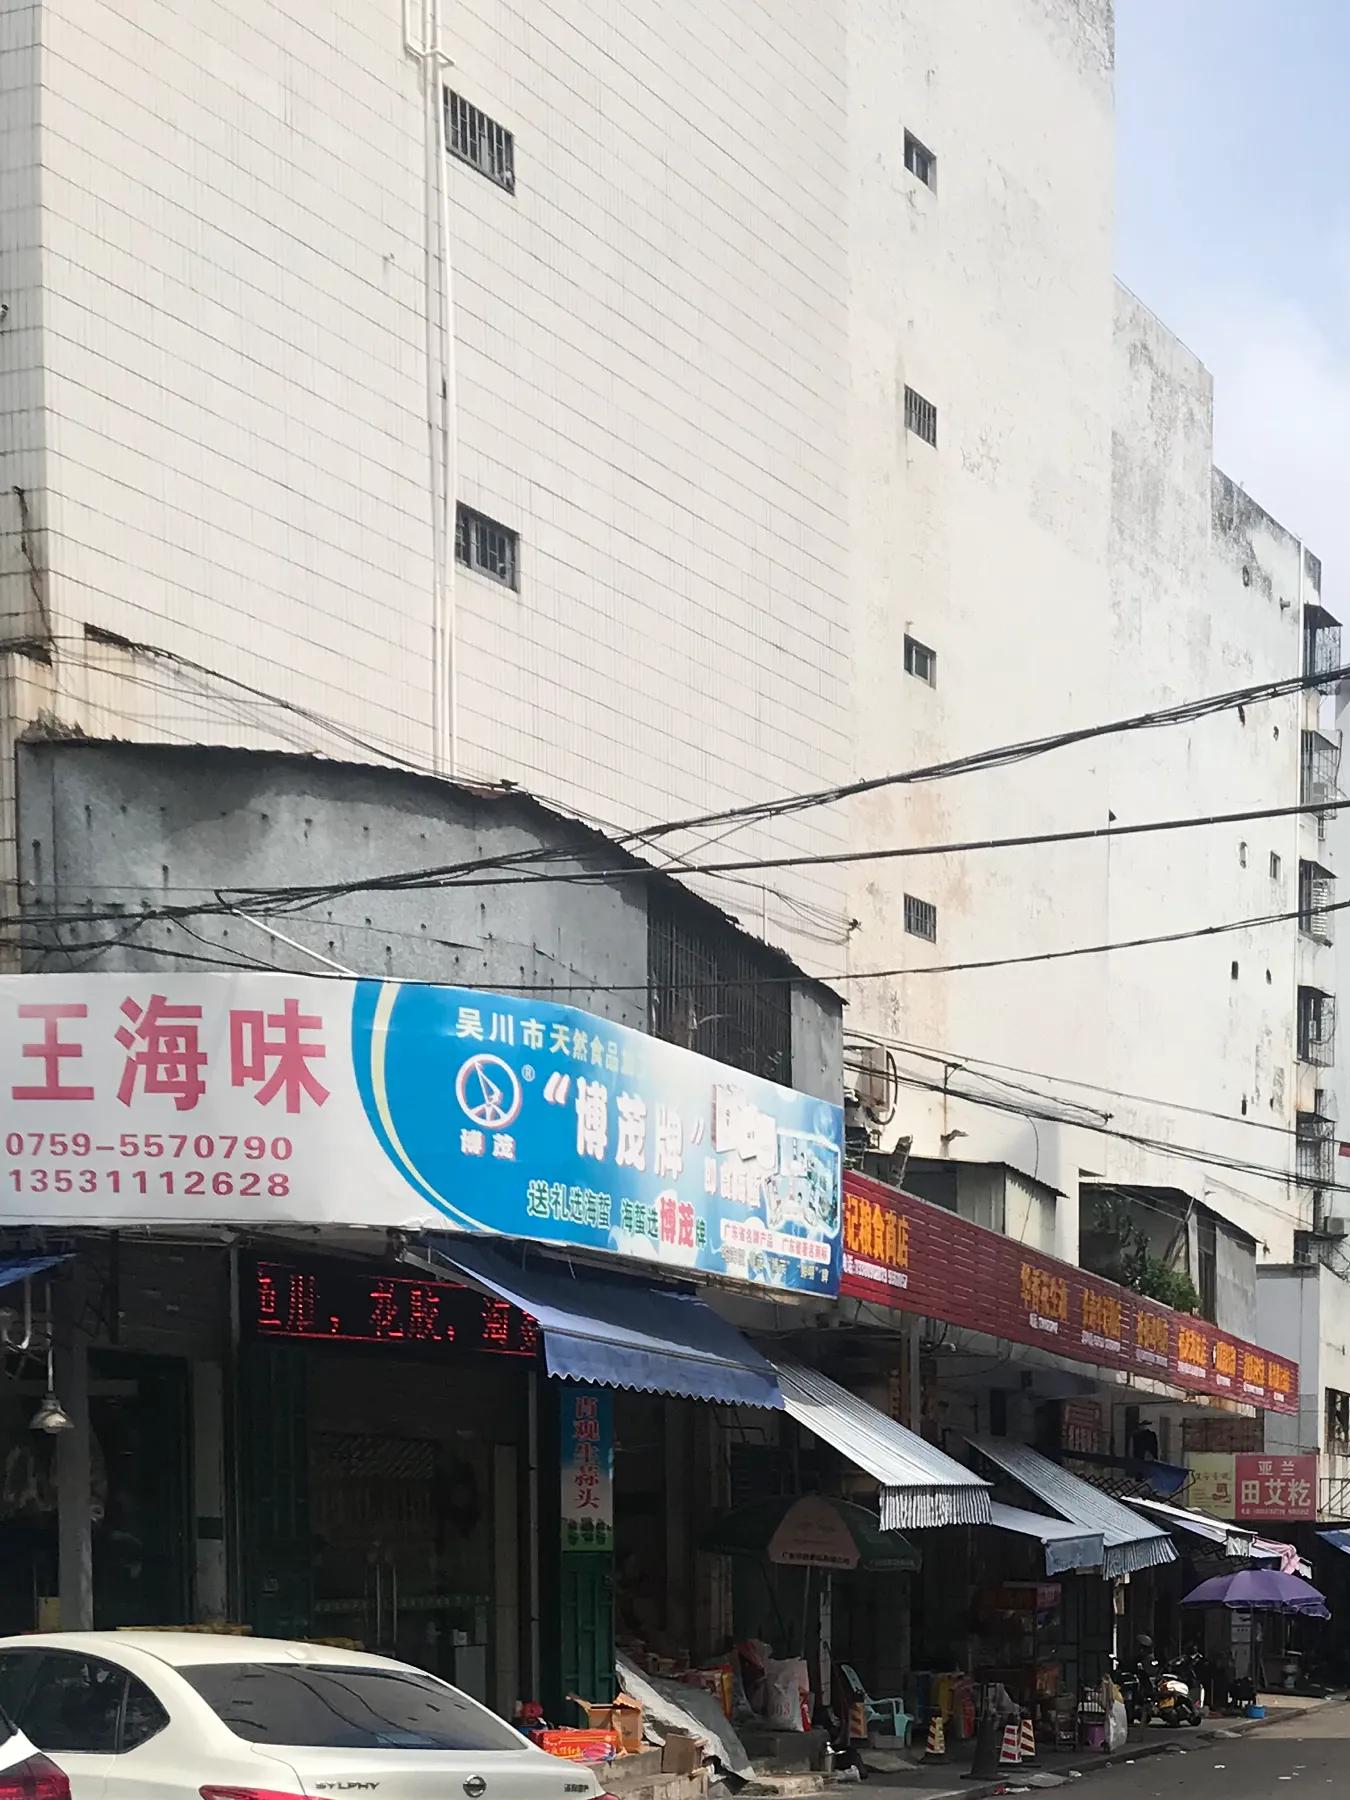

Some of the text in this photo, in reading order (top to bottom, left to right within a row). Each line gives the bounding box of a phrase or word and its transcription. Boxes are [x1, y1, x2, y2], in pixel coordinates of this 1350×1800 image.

[12, 993, 331, 1114] 王海味
[5, 1132, 294, 1161] 0759-5570790
[8, 1169, 291, 1197] 13531112628
[1258, 1460, 1295, 1476] 亚兰
[315, 1781, 381, 1791] SYLPHY
